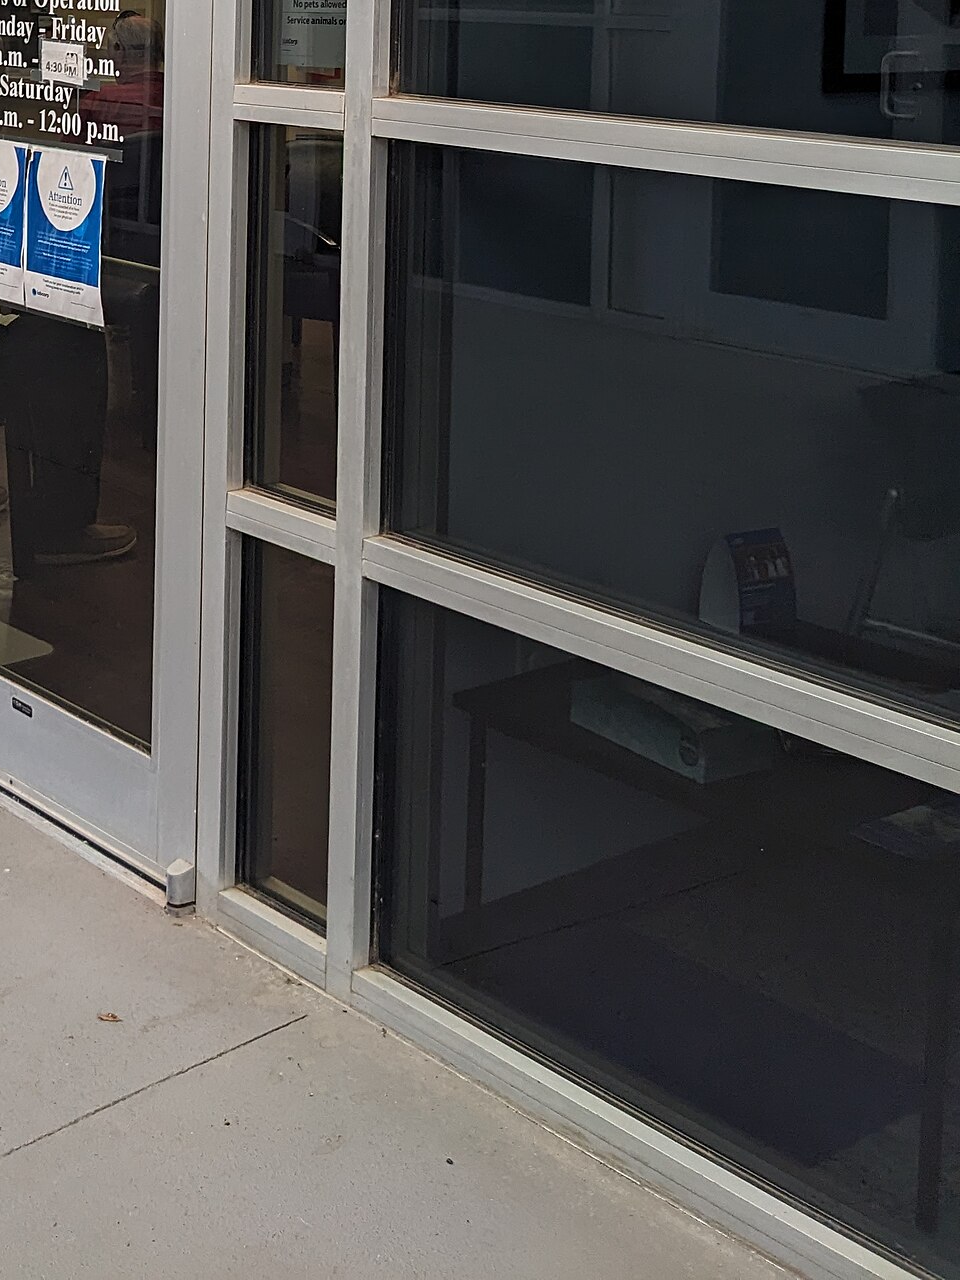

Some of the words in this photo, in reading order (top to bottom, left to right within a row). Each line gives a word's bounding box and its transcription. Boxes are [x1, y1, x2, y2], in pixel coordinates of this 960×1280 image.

[292, 0, 303, 8] No
[304, 0, 319, 10] pets
[320, 0, 348, 9] allowed
[286, 15, 310, 25] Service
[311, 16, 337, 26] animals
[51, 17, 107, 50] Friday
[45, 61, 63, 73] 4:30
[83, 57, 120, 81] p.m.
[0, 75, 75, 109] Saturday
[39, 109, 82, 137] 12:00
[85, 121, 124, 145] p.m.
[48, 190, 83, 206] Attention
